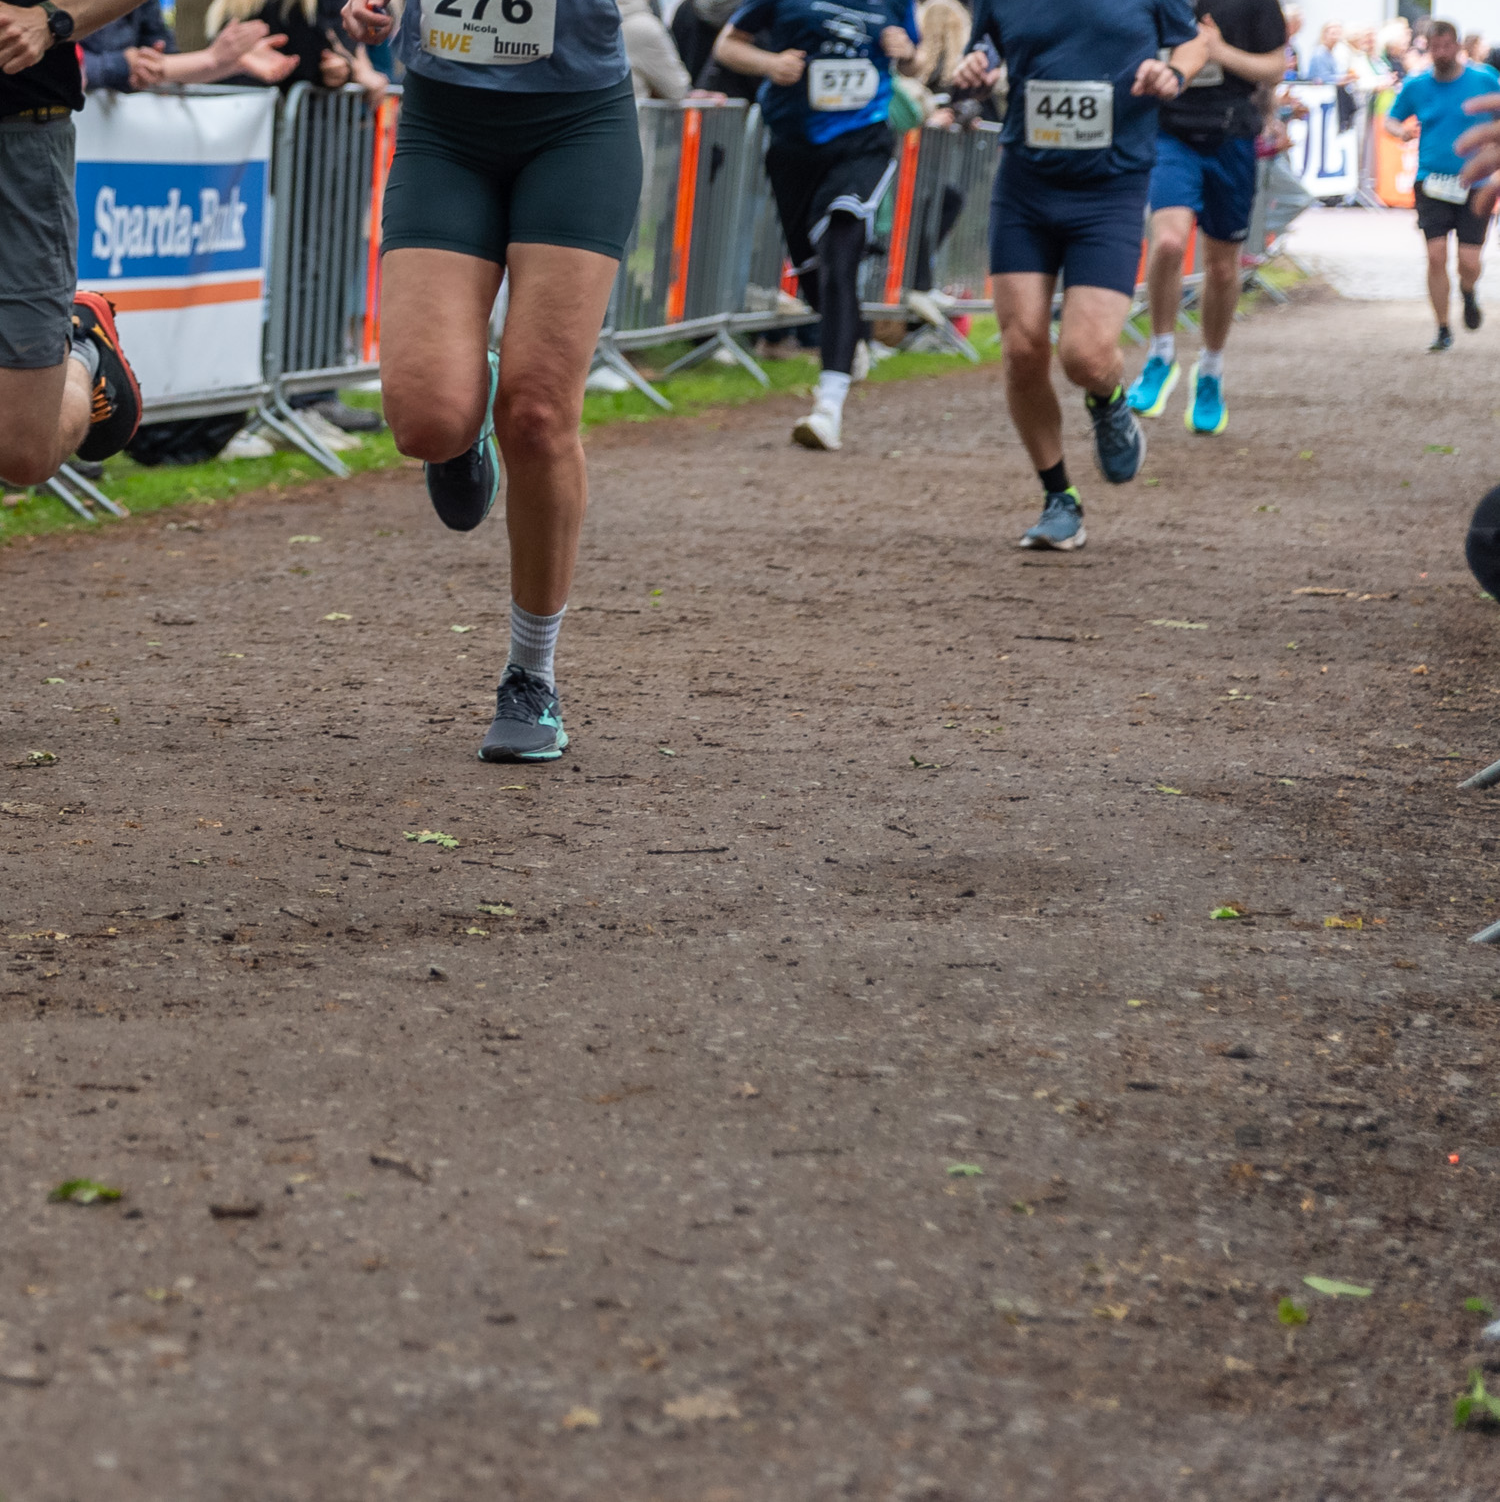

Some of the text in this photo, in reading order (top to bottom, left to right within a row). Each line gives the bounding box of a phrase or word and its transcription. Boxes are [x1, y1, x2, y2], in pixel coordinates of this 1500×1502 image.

[463, 22, 498, 34] Nicola
[429, 29, 540, 56] EWE bruns
[822, 69, 866, 90] 577
[1036, 95, 1099, 121] 448
